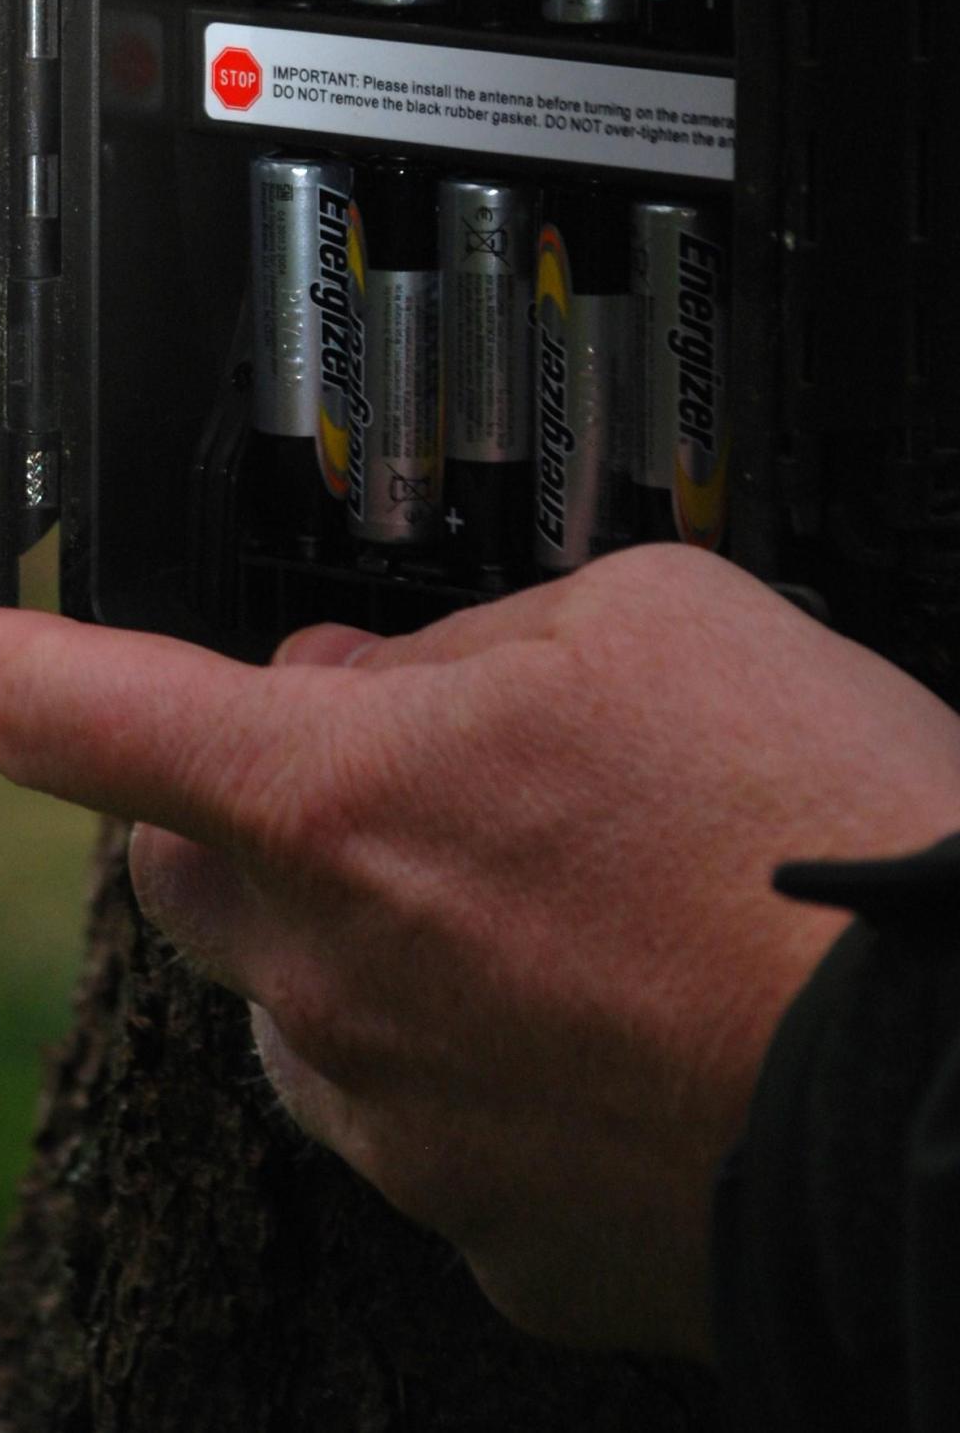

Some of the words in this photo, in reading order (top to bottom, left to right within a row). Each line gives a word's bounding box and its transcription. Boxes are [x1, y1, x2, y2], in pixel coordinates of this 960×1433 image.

[219, 69, 257, 88] STOP
[272, 66, 360, 88] IMPORTANT:
[363, 75, 409, 94] Please
[411, 80, 451, 98] install
[454, 85, 476, 101] the
[479, 90, 533, 108] antenna
[536, 94, 581, 113] before
[584, 100, 632, 122] turning
[635, 107, 653, 121] on
[656, 107, 679, 123] the
[272, 84, 295, 99] DO
[298, 88, 328, 103] NOT
[330, 93, 379, 109] remove
[382, 96, 403, 111] the
[406, 99, 442, 117] black
[445, 105, 489, 121] rubber
[491, 111, 541, 127] gasket.
[544, 114, 567, 130] DO
[569, 117, 602, 134] NOT
[604, 124, 689, 143] over-tighten
[692, 130, 714, 147] the
[309, 186, 352, 393] Energizer
[668, 231, 723, 452] Energizer
[537, 332, 575, 552] Energizer
